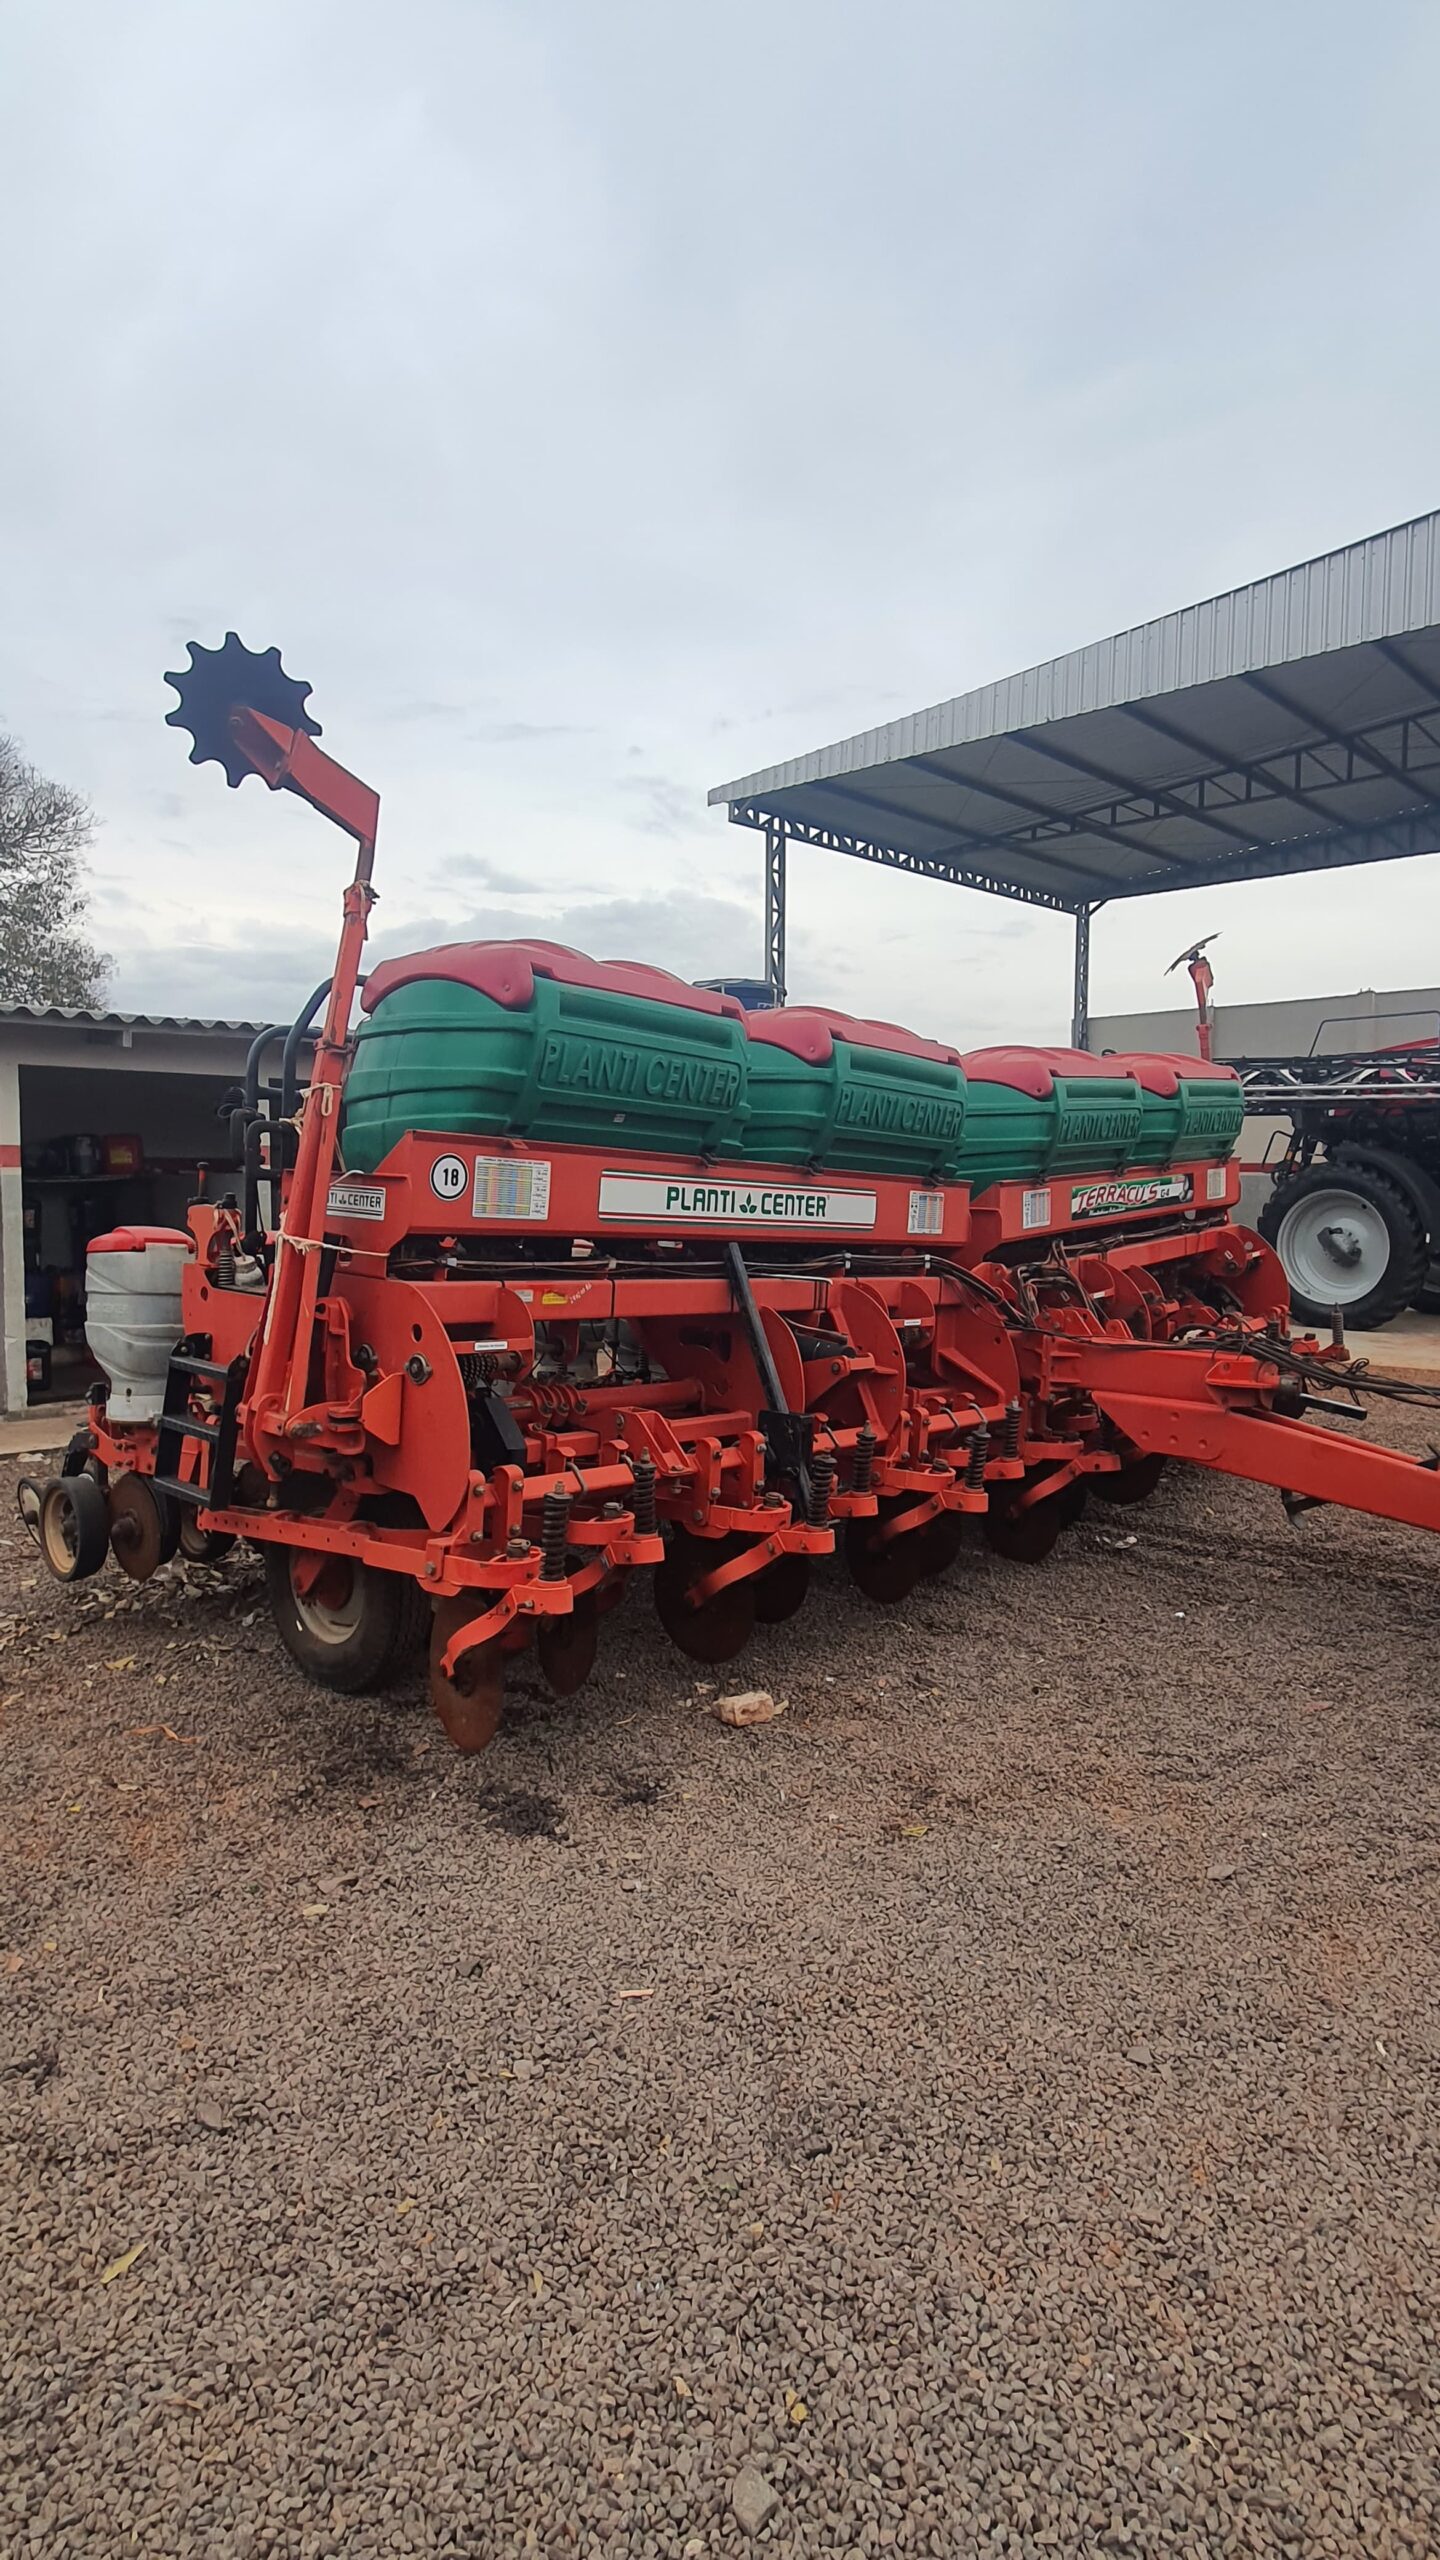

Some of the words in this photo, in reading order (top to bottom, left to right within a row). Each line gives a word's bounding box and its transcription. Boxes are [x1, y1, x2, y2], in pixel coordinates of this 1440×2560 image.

[541, 1038, 641, 1093] PLANTI
[646, 1054, 740, 1107] CENTER
[837, 1088, 899, 1129] PLANTI
[902, 1096, 961, 1137] CENTER
[443, 1168, 459, 1187] 18
[348, 1193, 382, 1209] CENTER
[666, 1186, 736, 1213] PLANTI
[761, 1193, 826, 1217] CENTER
